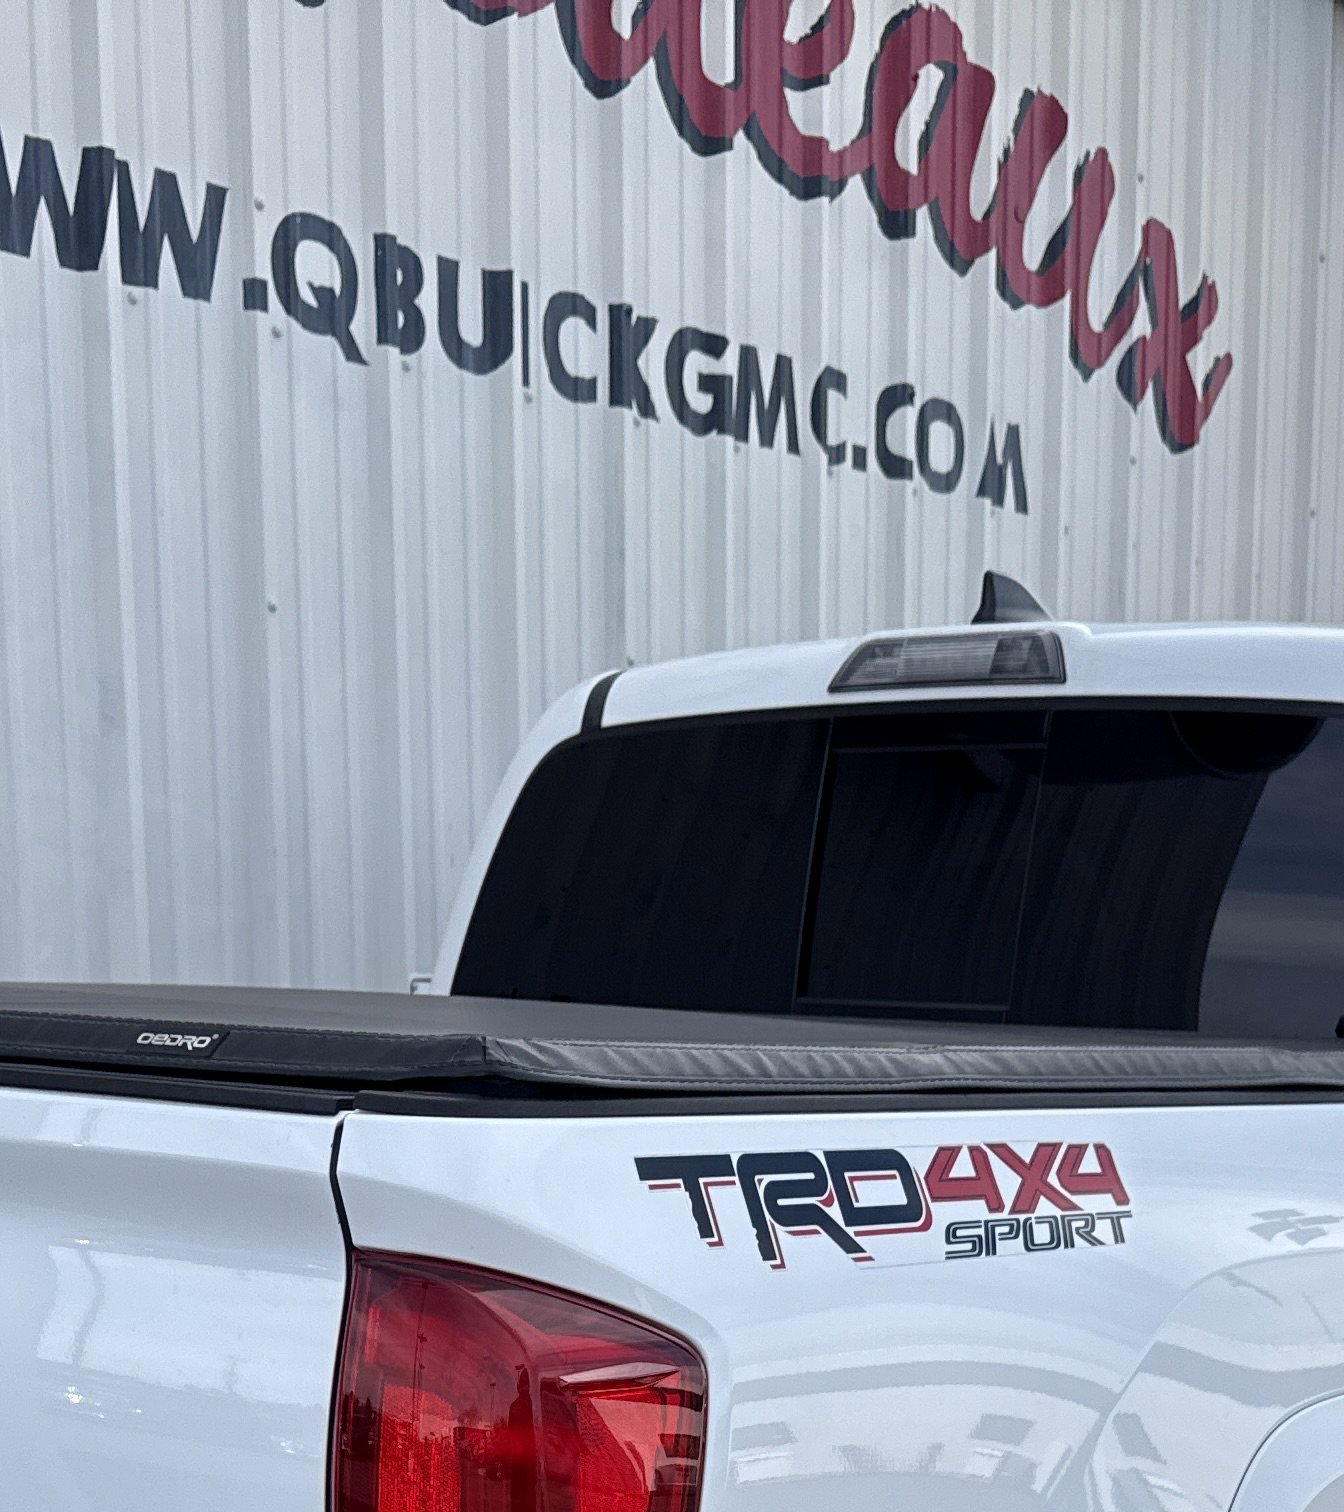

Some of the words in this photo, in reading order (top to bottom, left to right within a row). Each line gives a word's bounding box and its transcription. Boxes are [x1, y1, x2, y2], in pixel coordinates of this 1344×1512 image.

[436, 0, 1233, 453] eaux
[634, 1148, 932, 1271] TRD
[944, 1211, 1133, 1260] SPORT
